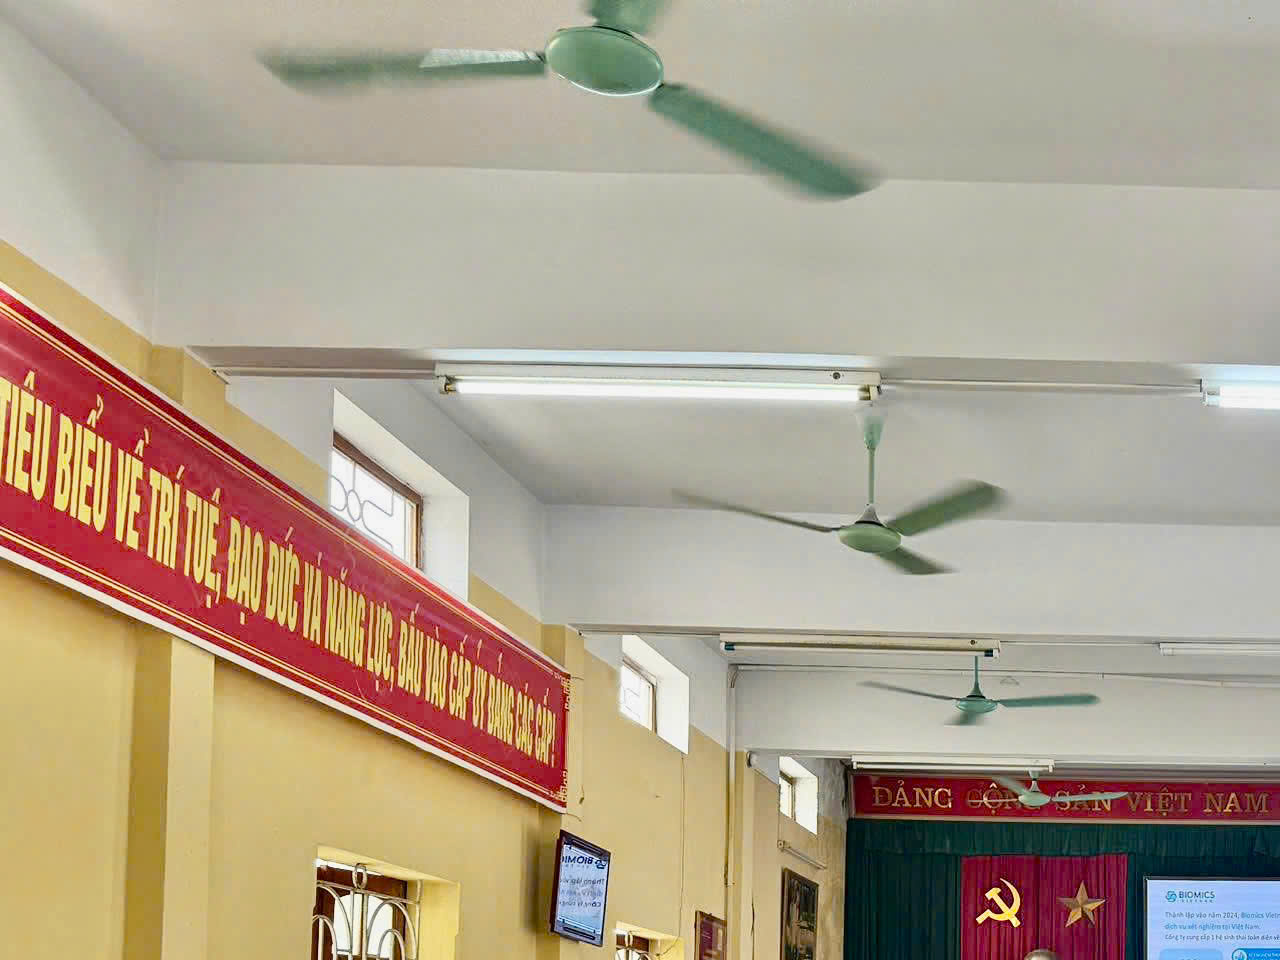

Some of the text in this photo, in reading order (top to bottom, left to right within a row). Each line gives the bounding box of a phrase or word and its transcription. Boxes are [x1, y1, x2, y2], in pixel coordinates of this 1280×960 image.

[54, 393, 112, 532] BIỂU
[115, 427, 149, 551] VỀ
[147, 464, 185, 570] TRÍ
[184, 487, 222, 608] TUỆ,
[226, 516, 264, 625] ĐẠO
[265, 526, 300, 632] ĐỨC
[325, 566, 366, 667] NĂNG
[366, 600, 395, 692] LỰC,
[425, 626, 448, 711] VÀO
[449, 634, 471, 720] CẤP
[487, 652, 514, 747] ĐẢNG
[515, 682, 534, 757] CÁC
[535, 688, 556, 768] CẤP!
[871, 780, 954, 809] ĐẢNG
[1127, 787, 1192, 817] VIỆT
[1203, 792, 1269, 814] NAM
[1179, 891, 1215, 899] BIOMICS
